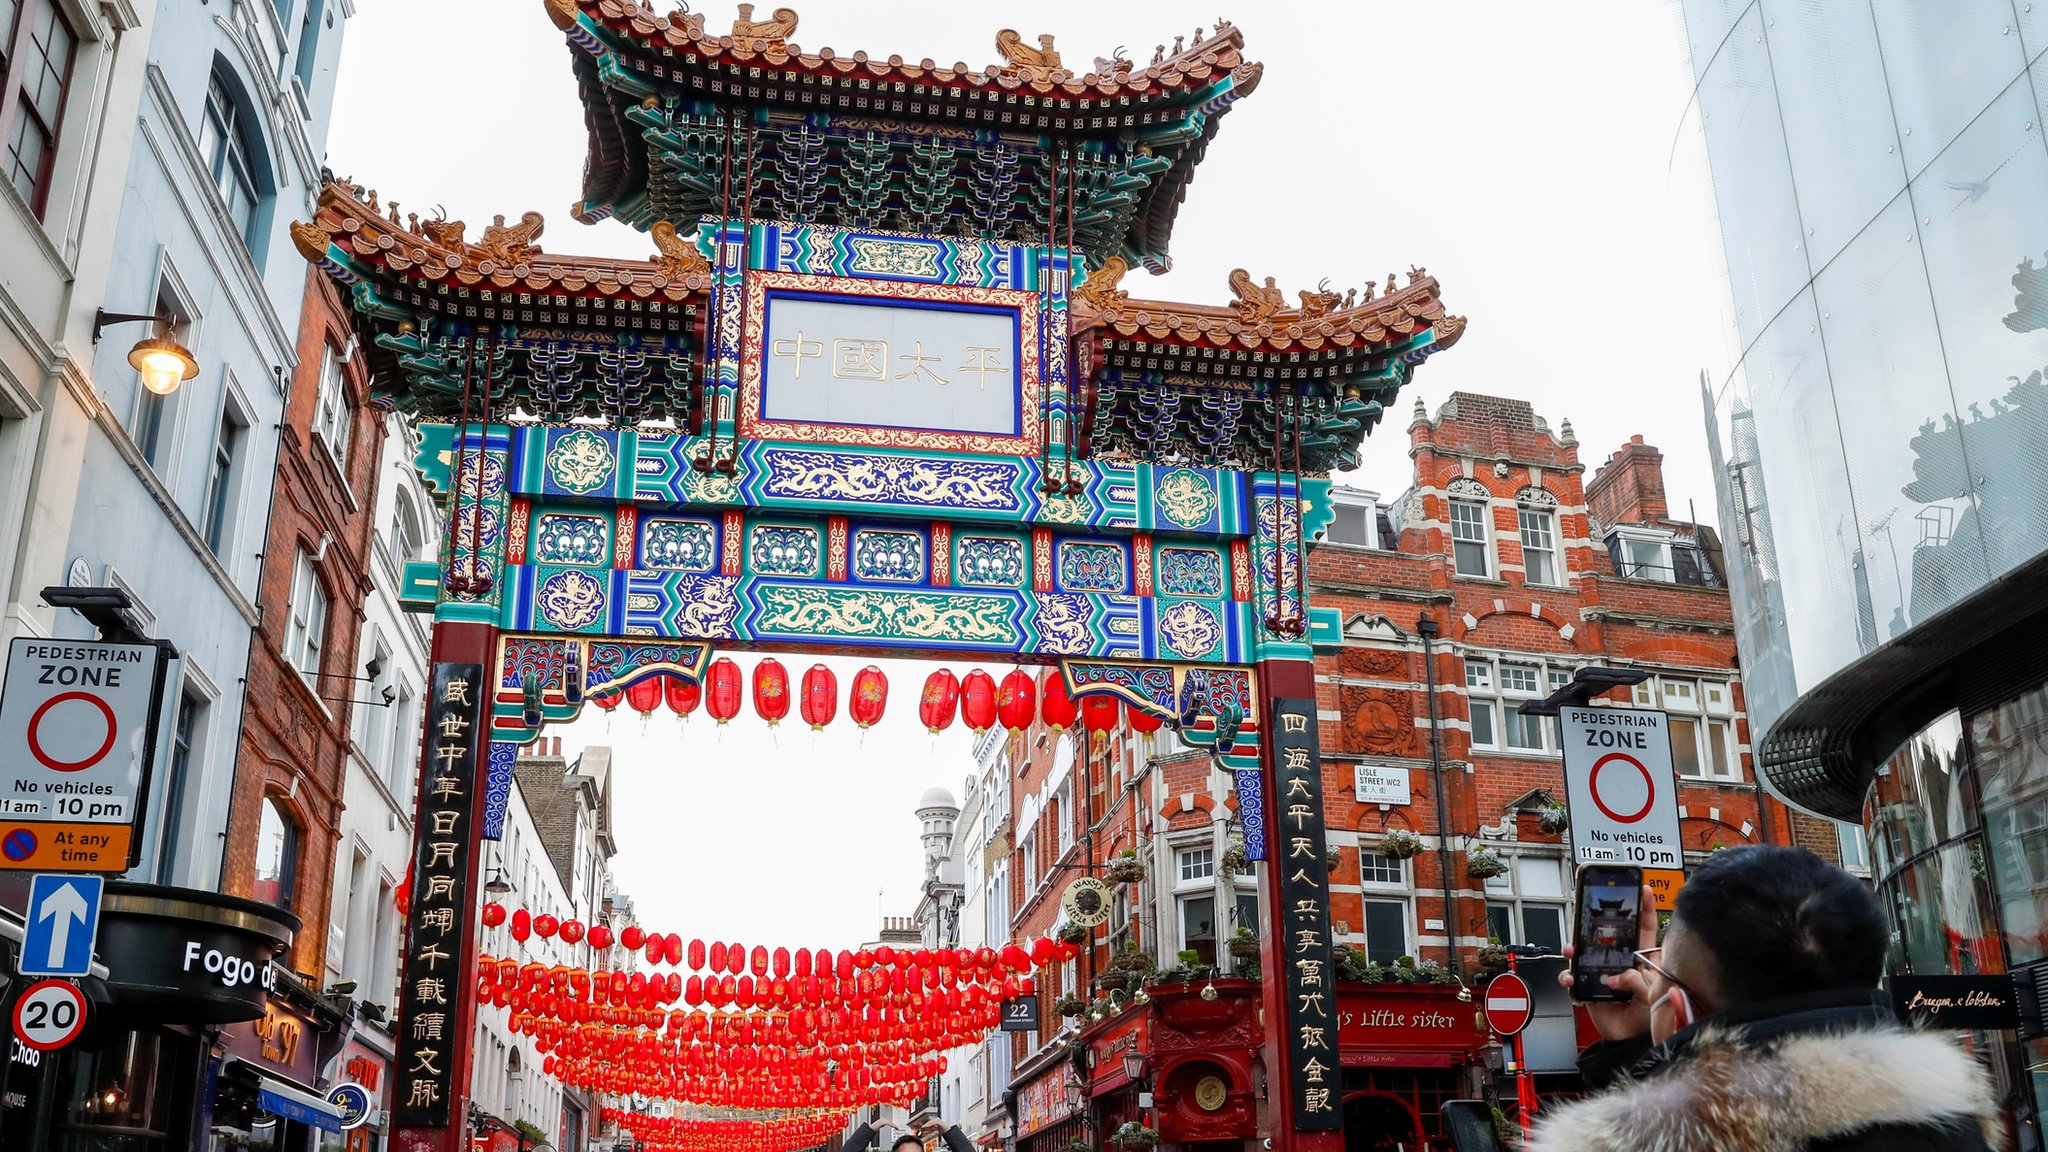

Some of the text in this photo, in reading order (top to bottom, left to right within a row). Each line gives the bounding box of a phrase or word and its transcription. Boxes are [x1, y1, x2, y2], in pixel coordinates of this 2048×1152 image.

[773, 330, 1009, 391] 中國太平
[27, 646, 141, 662] PEDESTRIAN
[38, 665, 122, 687] ZONE
[1572, 712, 1657, 727] PEDESTRIAN
[1586, 729, 1647, 749] ZONE
[1359, 768, 1377, 776] LISLE
[14, 780, 113, 795] No vehicles
[1359, 777, 1384, 785] STREET
[54, 832, 110, 848] At any
[1591, 830, 1663, 844] No vehicles
[61, 849, 98, 862] time
[1649, 878, 1670, 890] any
[183, 941, 277, 992] Fogo de
[1908, 990, 1954, 1013] Burger
[1965, 990, 2001, 1007] lobster
[26, 1001, 76, 1029] 20
[1010, 1004, 1028, 1017] 22
[1360, 1010, 1405, 1027] Little
[1410, 1011, 1455, 1028] sister
